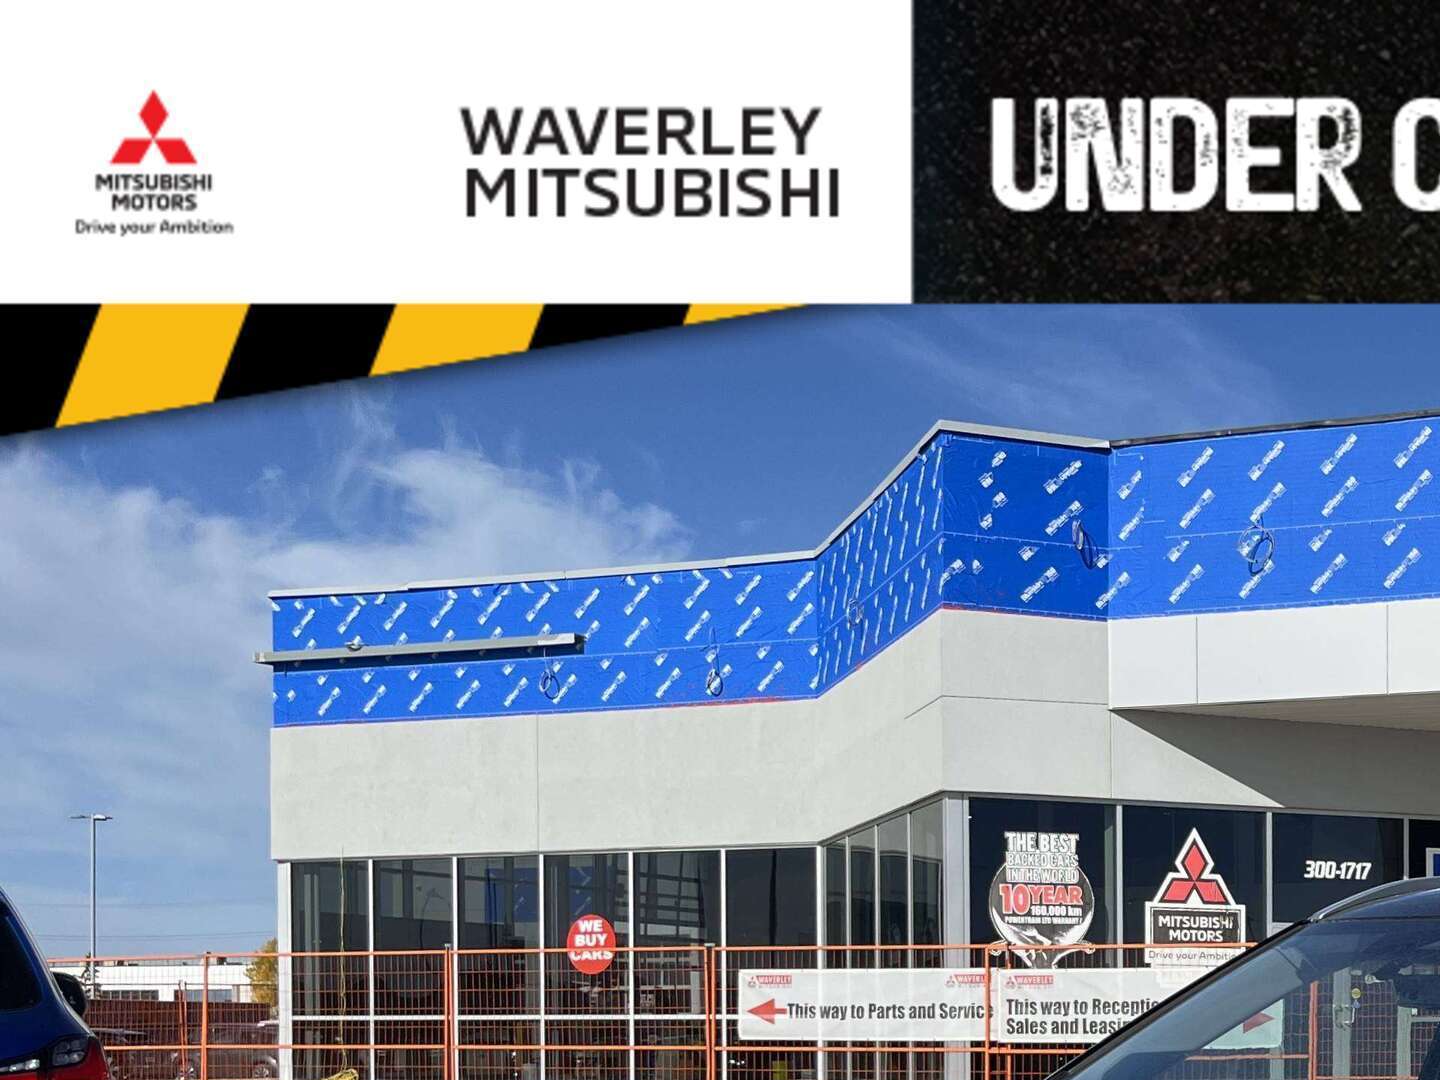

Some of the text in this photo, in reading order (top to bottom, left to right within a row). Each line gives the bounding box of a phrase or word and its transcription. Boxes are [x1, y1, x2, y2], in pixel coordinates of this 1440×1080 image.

[1004, 832, 1079, 853] THE BEST
[1007, 853, 1079, 866] BACKED CARS
[1007, 869, 1079, 882] IN THE WORLD
[1304, 861, 1372, 880] 300-1717
[1000, 884, 1083, 914] 10 YEAR
[1031, 906, 1082, 916] 160,000 km
[579, 920, 603, 932] WE
[1158, 916, 1233, 929] MITSUBISHI
[575, 934, 608, 947] BUY
[1169, 930, 1224, 942] MOTORS
[570, 950, 613, 960] CARS
[1149, 951, 1238, 960] Drive your Ambitio
[787, 1003, 816, 1019] This
[820, 1006, 847, 1020] way
[851, 1004, 864, 1019] to
[869, 1003, 905, 1019] Parts
[909, 1003, 935, 1019] and
[1007, 999, 1037, 1015] This
[1041, 1002, 1069, 1017] way
[1074, 1000, 1088, 1015] to
[1007, 1018, 1047, 1035] Sales
[1051, 1018, 1079, 1035] and
